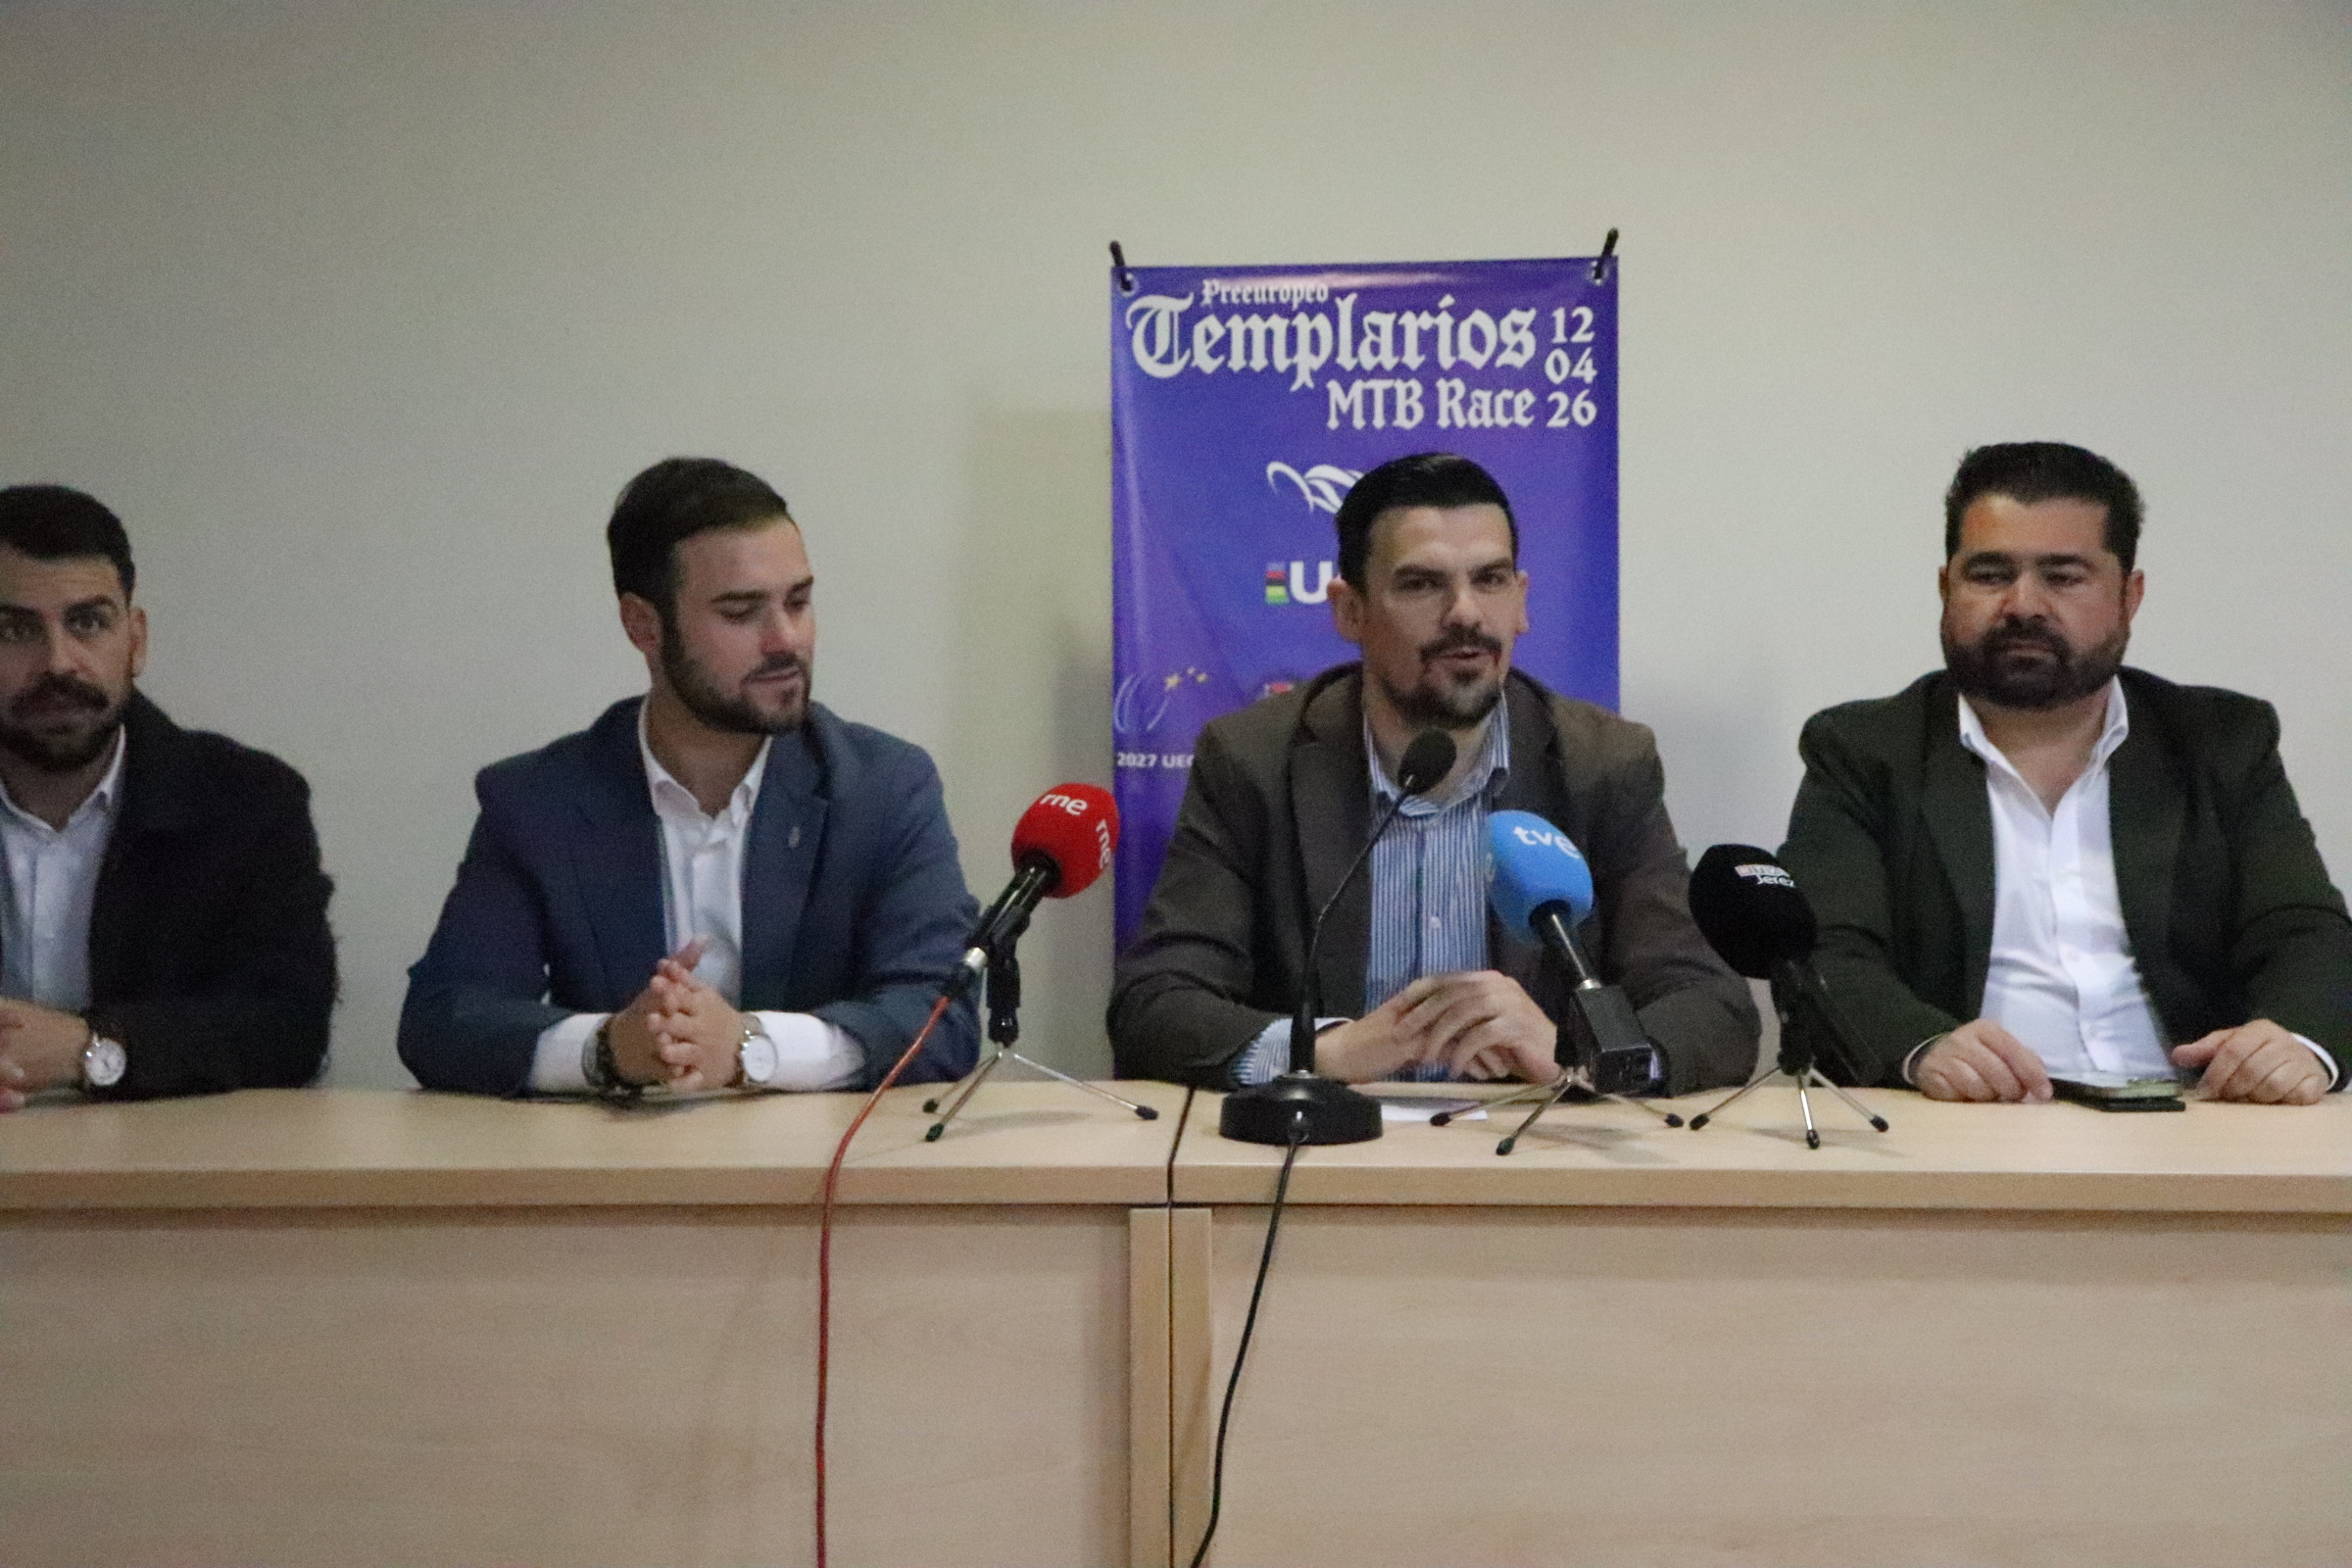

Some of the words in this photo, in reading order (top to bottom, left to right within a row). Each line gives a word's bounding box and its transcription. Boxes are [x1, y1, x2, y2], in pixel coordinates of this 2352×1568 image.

[1125, 293, 1537, 392] Templarios
[1550, 306, 1595, 344] 12
[1544, 347, 1597, 384] 04
[1326, 378, 1425, 429] MTB
[1436, 377, 1537, 429] Race
[1545, 391, 1598, 427] 26
[1116, 752, 1157, 767] 2027
[1039, 793, 1088, 815] rne
[1096, 818, 1111, 869] rne
[1513, 826, 1582, 858] tve
